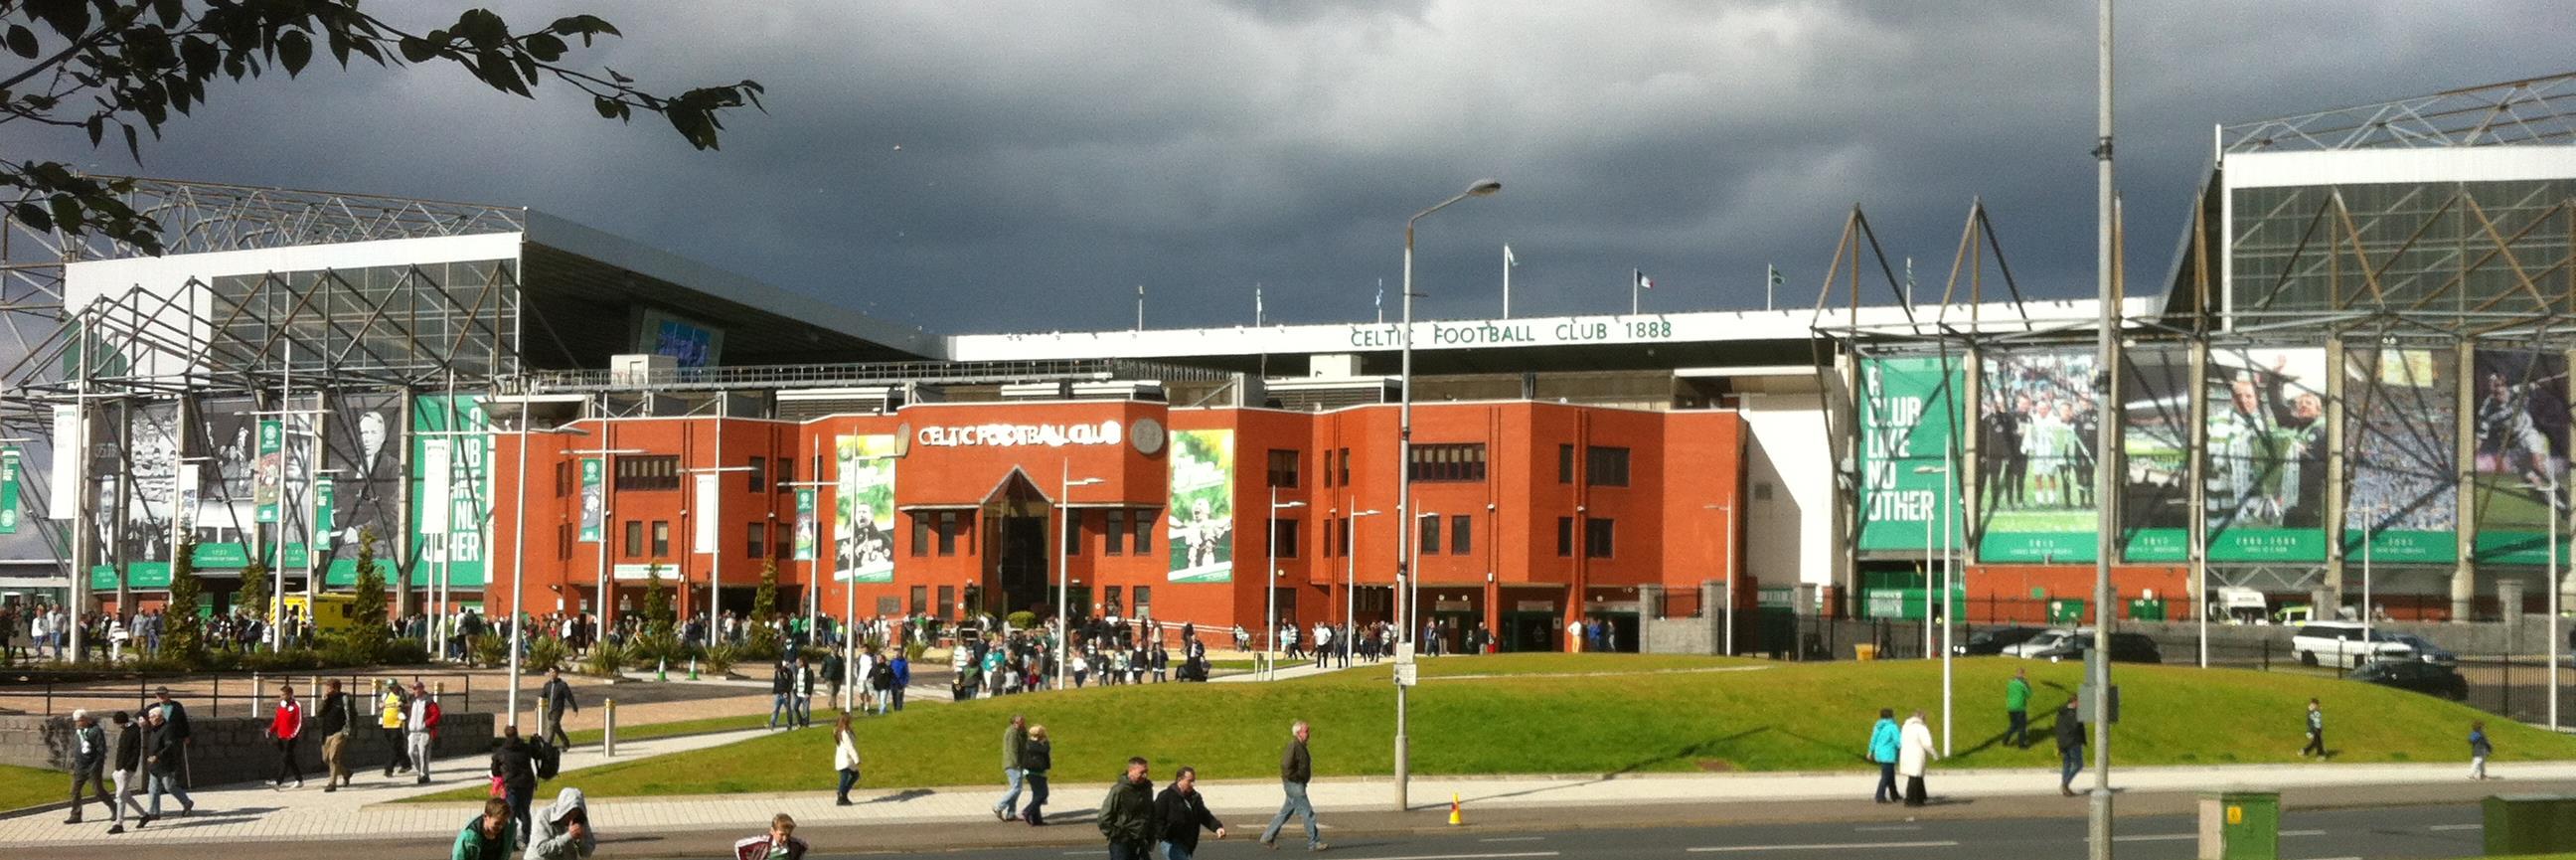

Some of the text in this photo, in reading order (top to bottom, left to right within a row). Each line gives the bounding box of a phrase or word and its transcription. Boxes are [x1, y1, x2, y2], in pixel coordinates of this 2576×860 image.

[1434, 324, 1535, 345] FOOTBALL
[1555, 323, 1607, 341] CLUB
[1625, 321, 1672, 339] 1888
[918, 425, 977, 446] CELTIC
[976, 423, 1070, 446] FOOTBALL
[451, 438, 482, 468] UB
[450, 469, 482, 499] IKE
[1867, 459, 1896, 490] NO
[454, 500, 480, 530] NO
[1867, 490, 1935, 522] OTHER
[422, 532, 480, 563] OHER
